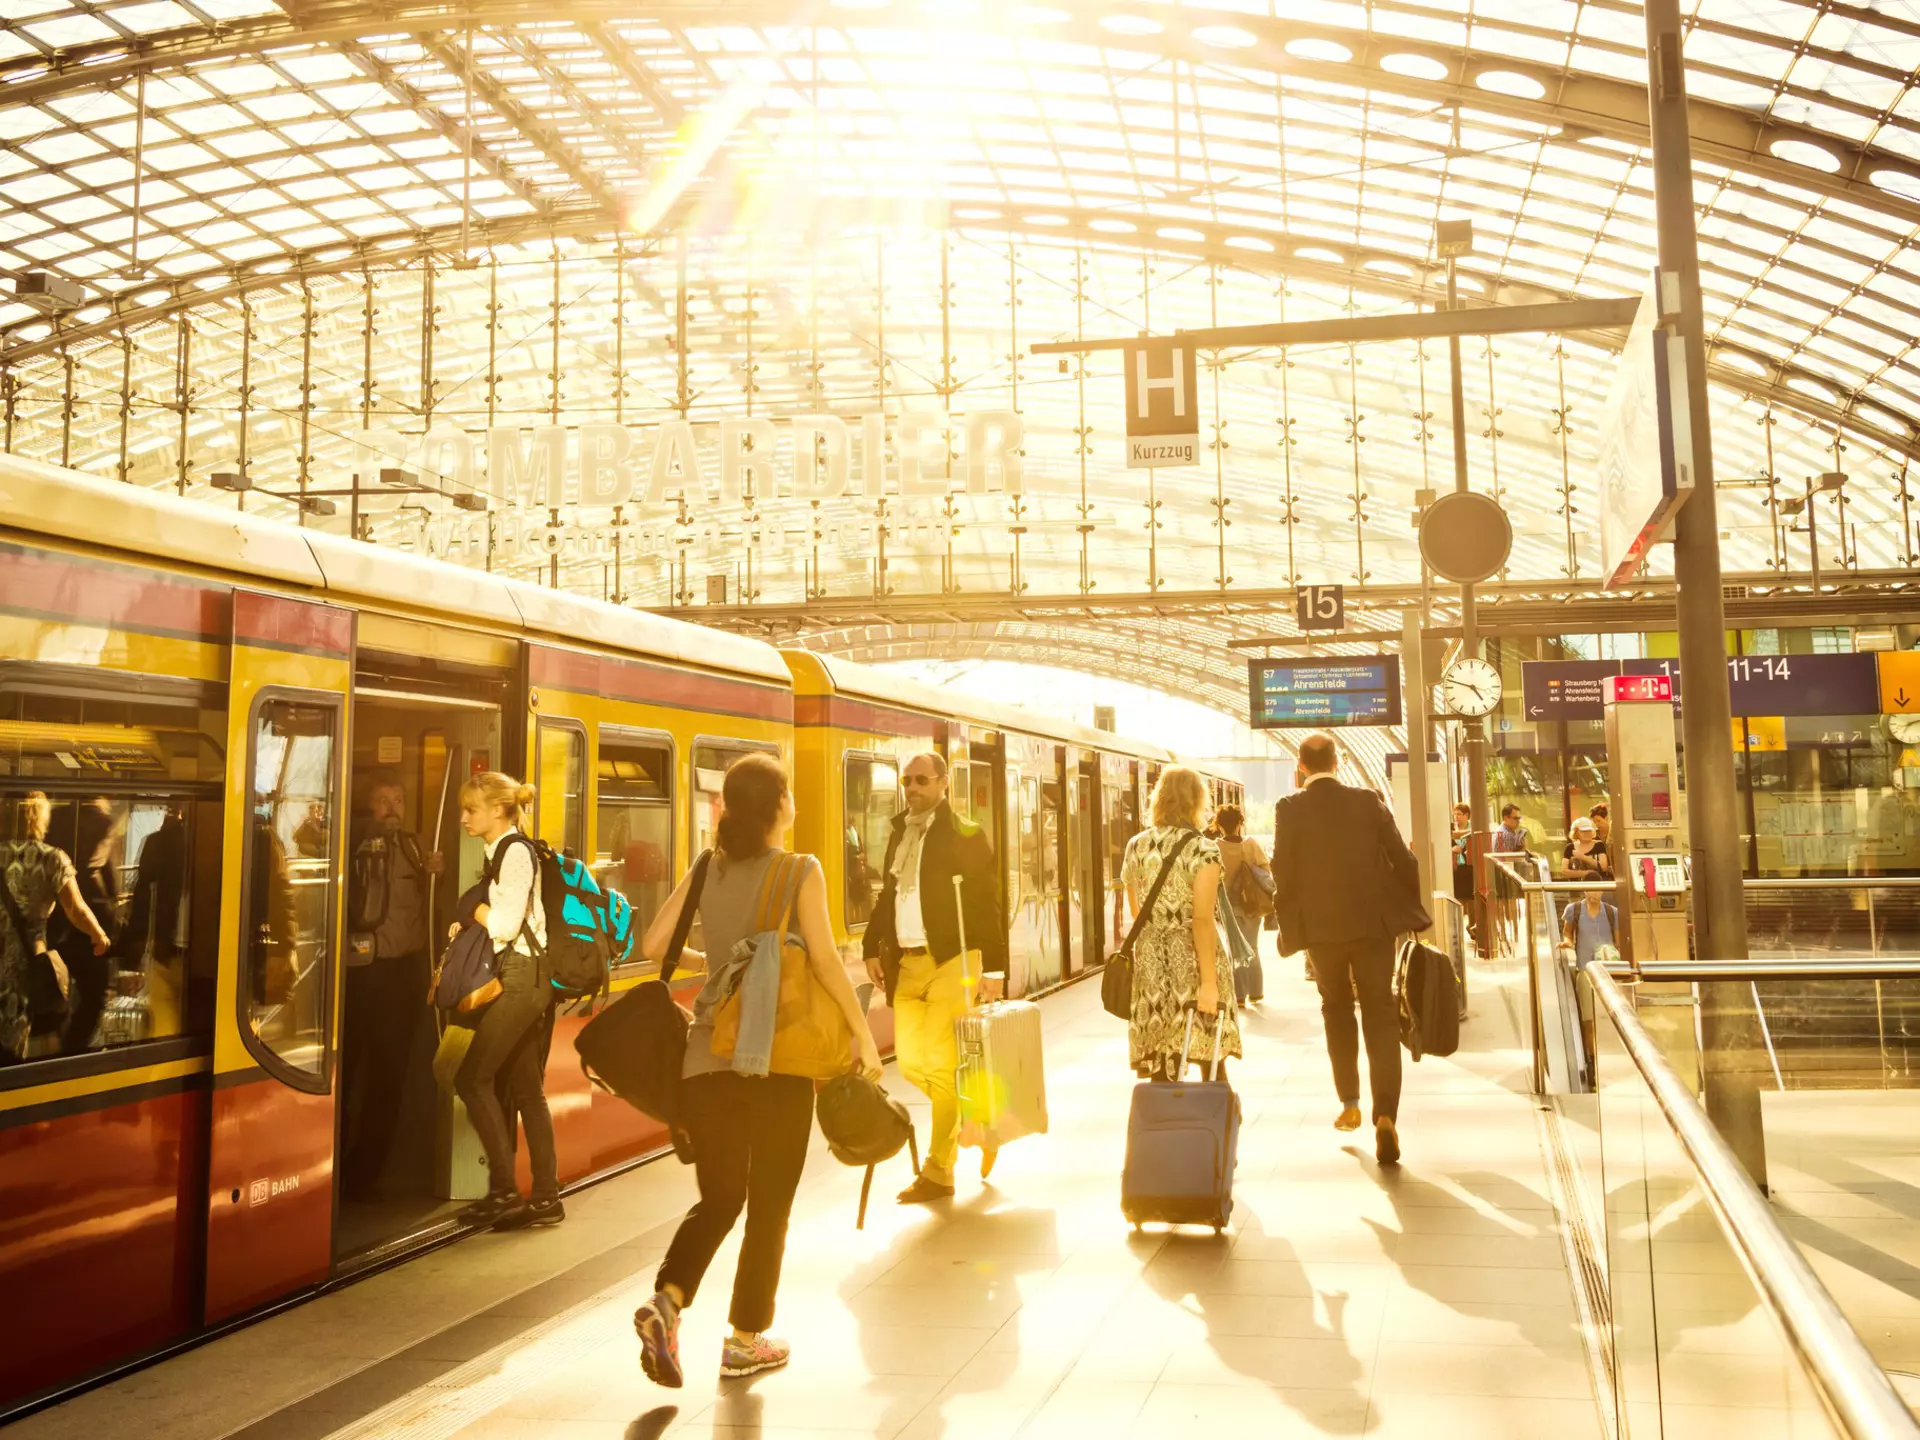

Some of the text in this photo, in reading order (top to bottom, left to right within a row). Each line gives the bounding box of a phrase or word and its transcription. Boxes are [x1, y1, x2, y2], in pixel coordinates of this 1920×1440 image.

[1136, 347, 1185, 418] H
[353, 410, 1024, 513] BOMBARDIER
[1133, 444, 1193, 461] Kurzzug
[1298, 586, 1338, 619] 15
[1263, 669, 1275, 679] S7
[1727, 657, 1791, 682] 11-14
[1294, 679, 1346, 689] Ahrensfelde
[1641, 678, 1658, 698] T
[1295, 698, 1330, 706] Wartenberg
[1295, 707, 1331, 715] Ahrensfelde
[272, 1175, 299, 1197] BAHN
